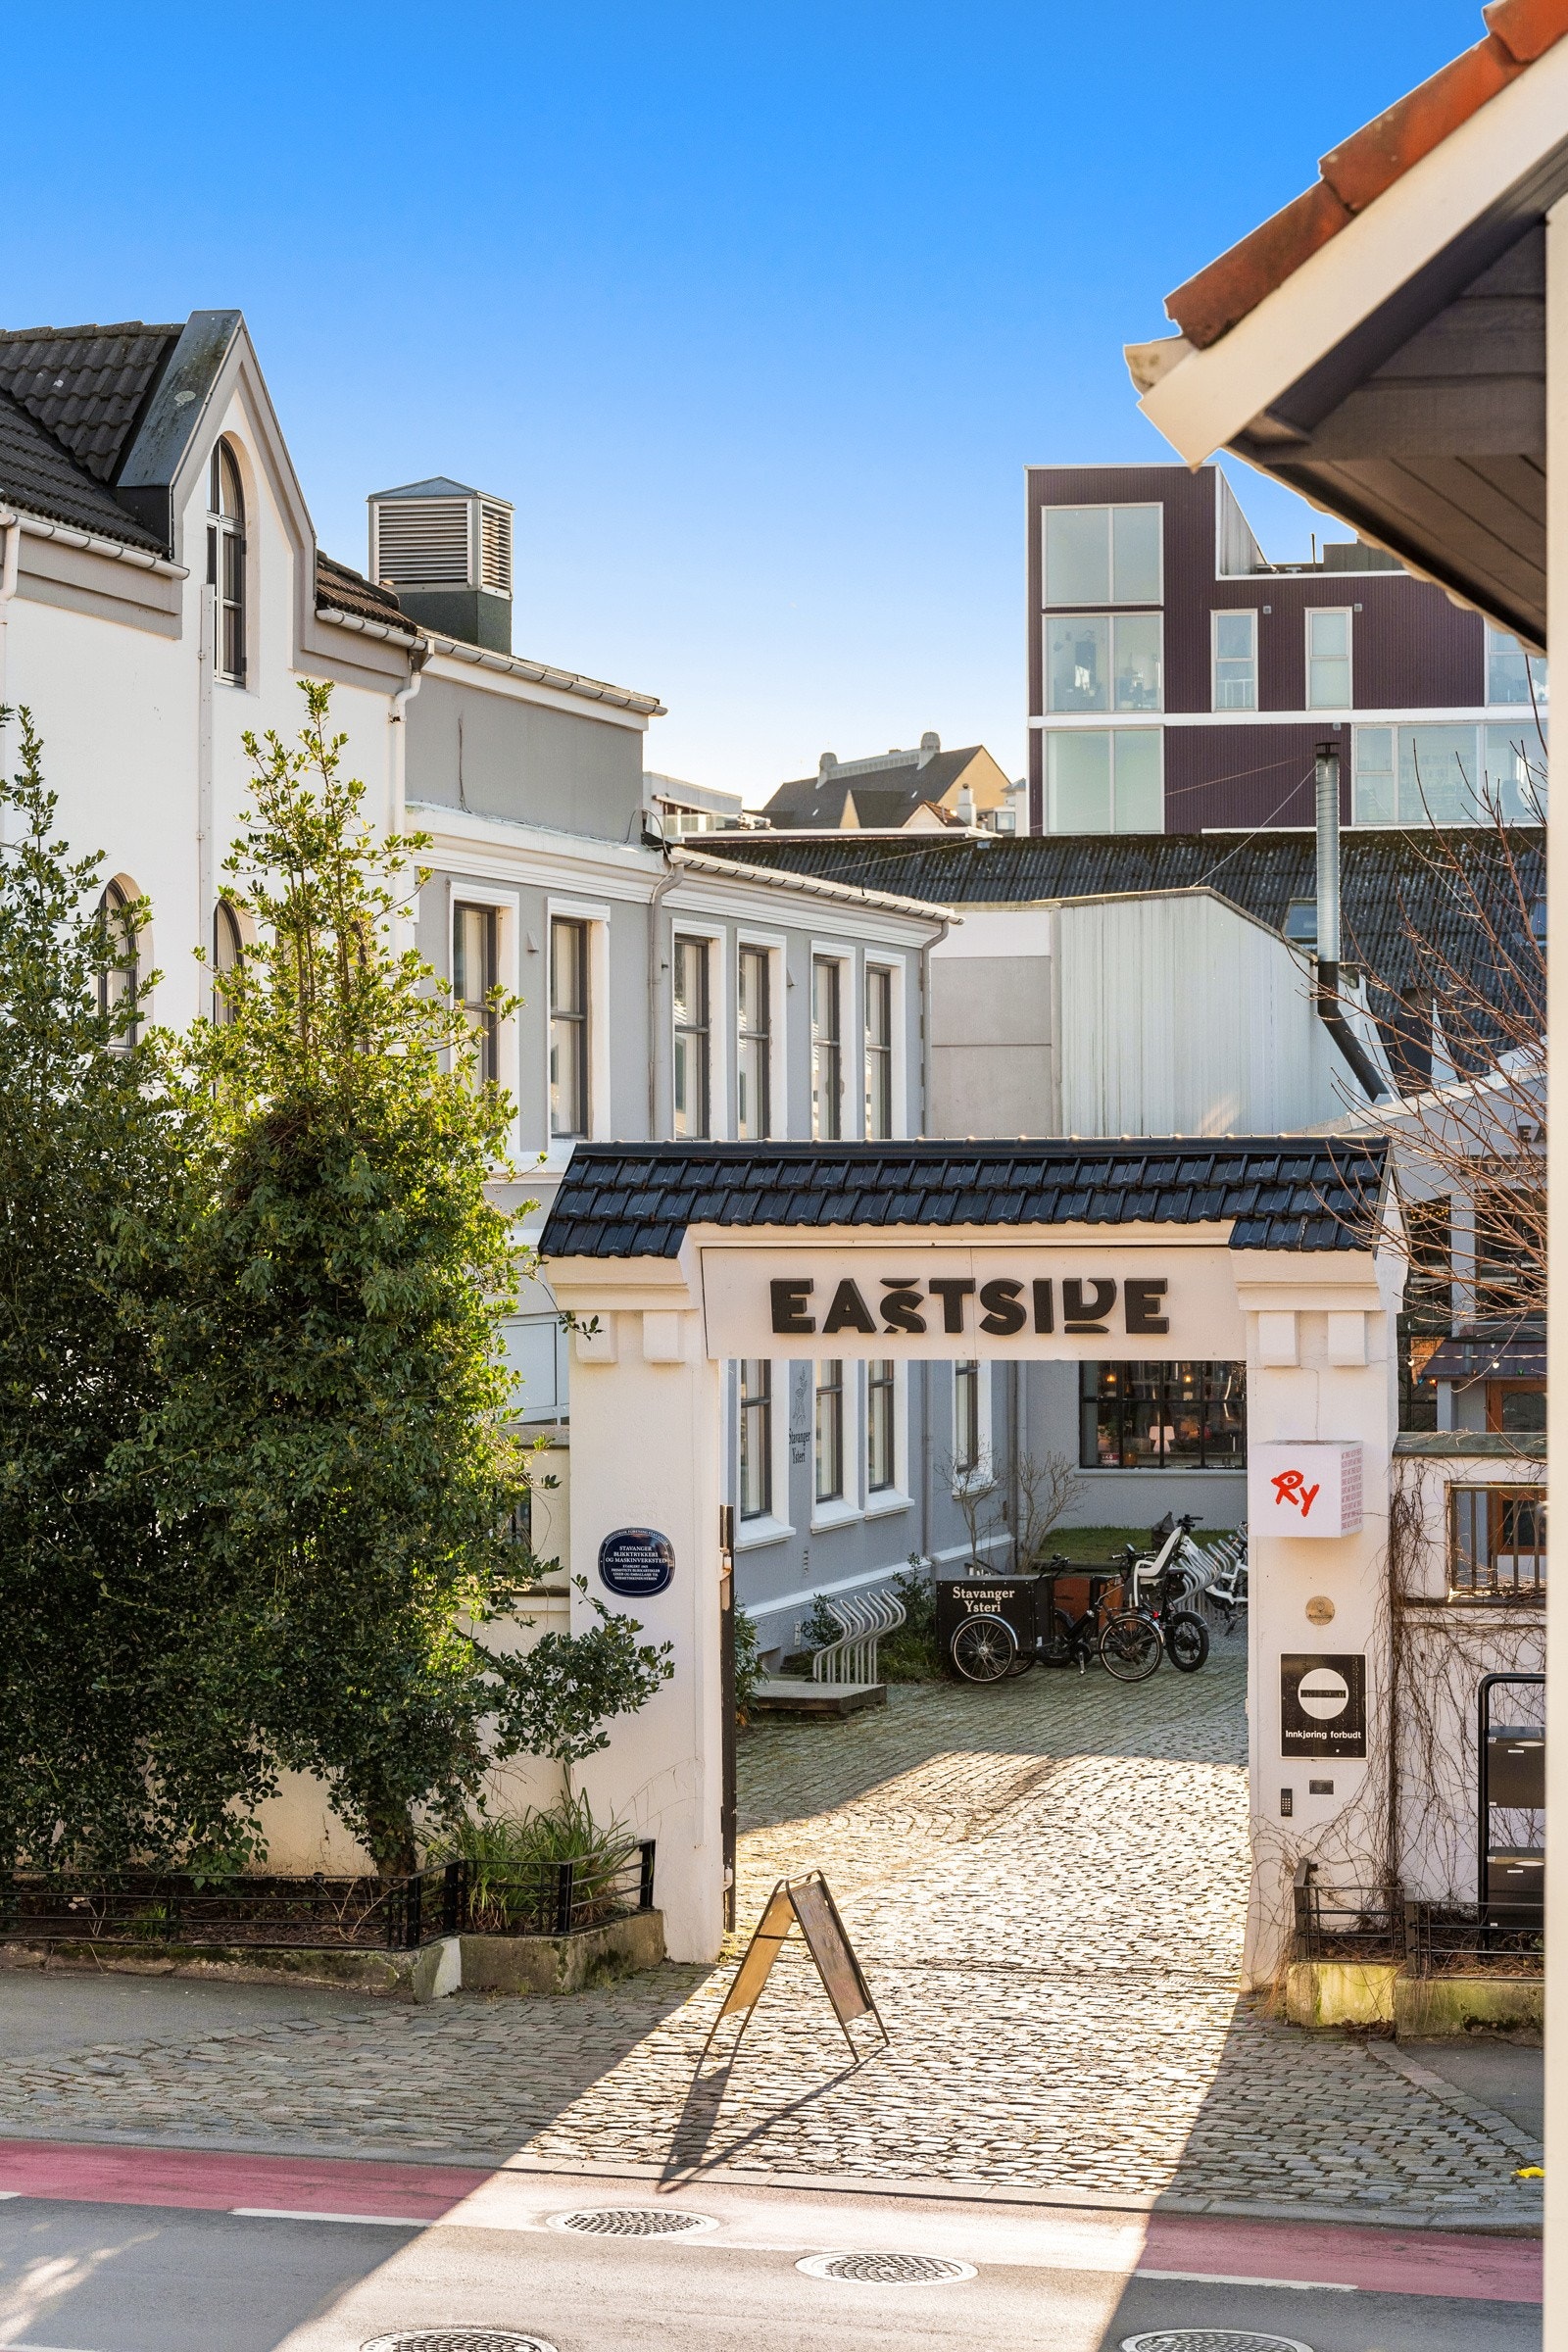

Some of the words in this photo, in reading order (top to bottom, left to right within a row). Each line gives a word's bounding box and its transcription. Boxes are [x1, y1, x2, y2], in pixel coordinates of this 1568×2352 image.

[770, 1278, 1170, 1336] EASTSIDE
[953, 1586, 1015, 1600] Stavanger
[964, 1599, 1002, 1613] Ysteri
[1285, 1730, 1327, 1740] Innkjøring
